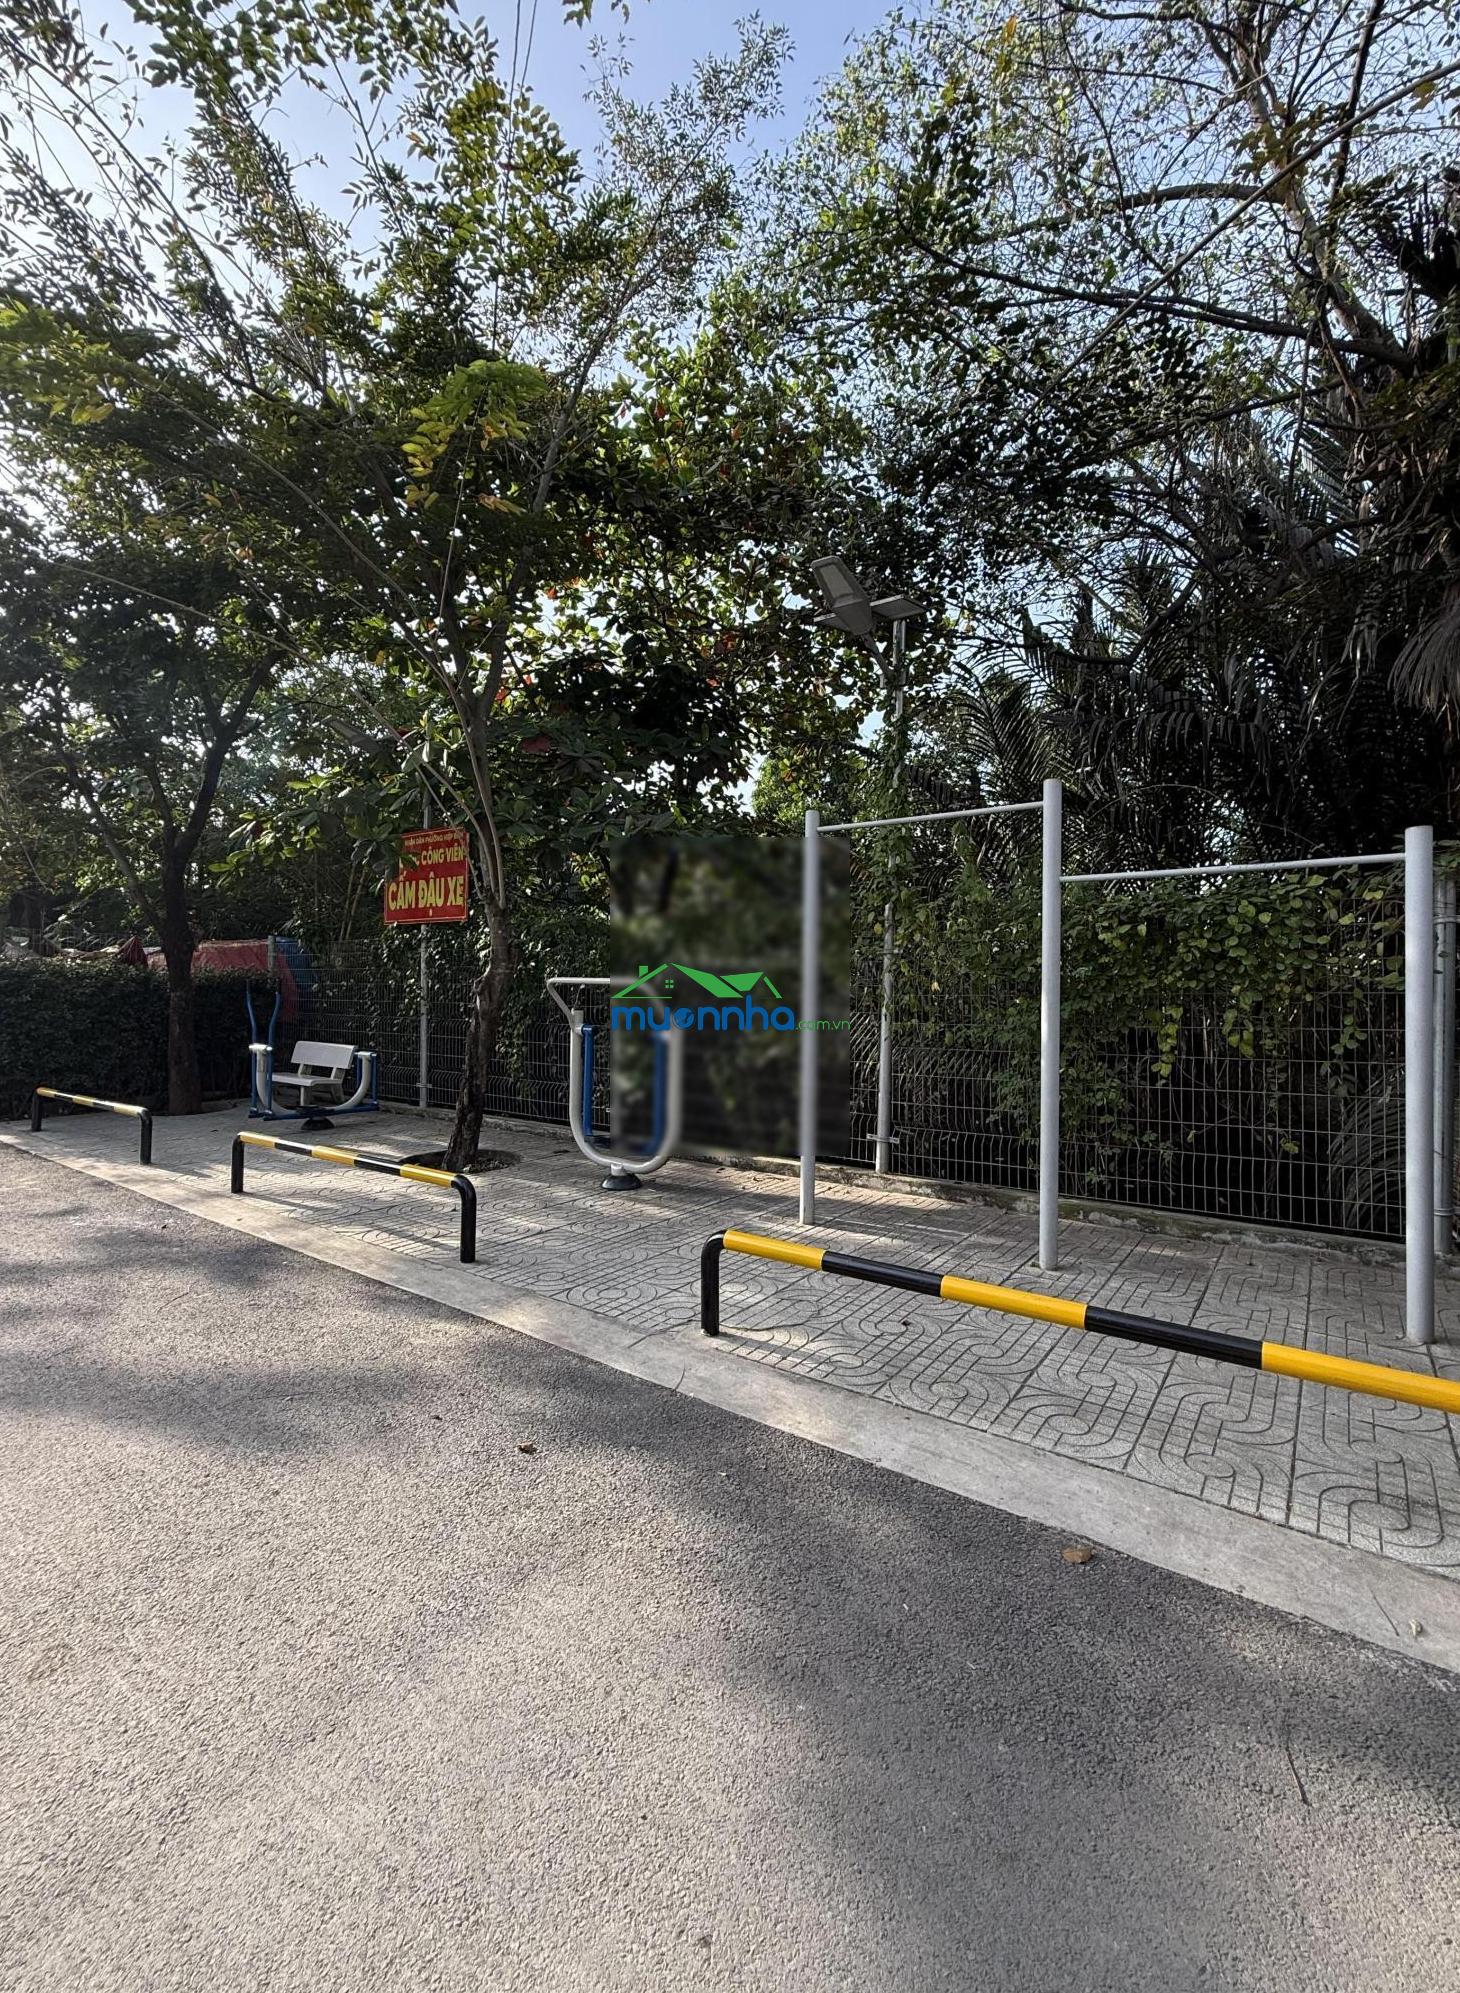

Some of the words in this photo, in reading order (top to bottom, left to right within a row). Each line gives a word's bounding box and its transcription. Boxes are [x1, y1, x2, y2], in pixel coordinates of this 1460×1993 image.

[421, 846, 444, 865] CÔNG
[446, 843, 465, 862] VIÊN
[388, 870, 416, 910] CẤM
[418, 871, 445, 916] ĐẬU
[447, 876, 464, 906] XE
